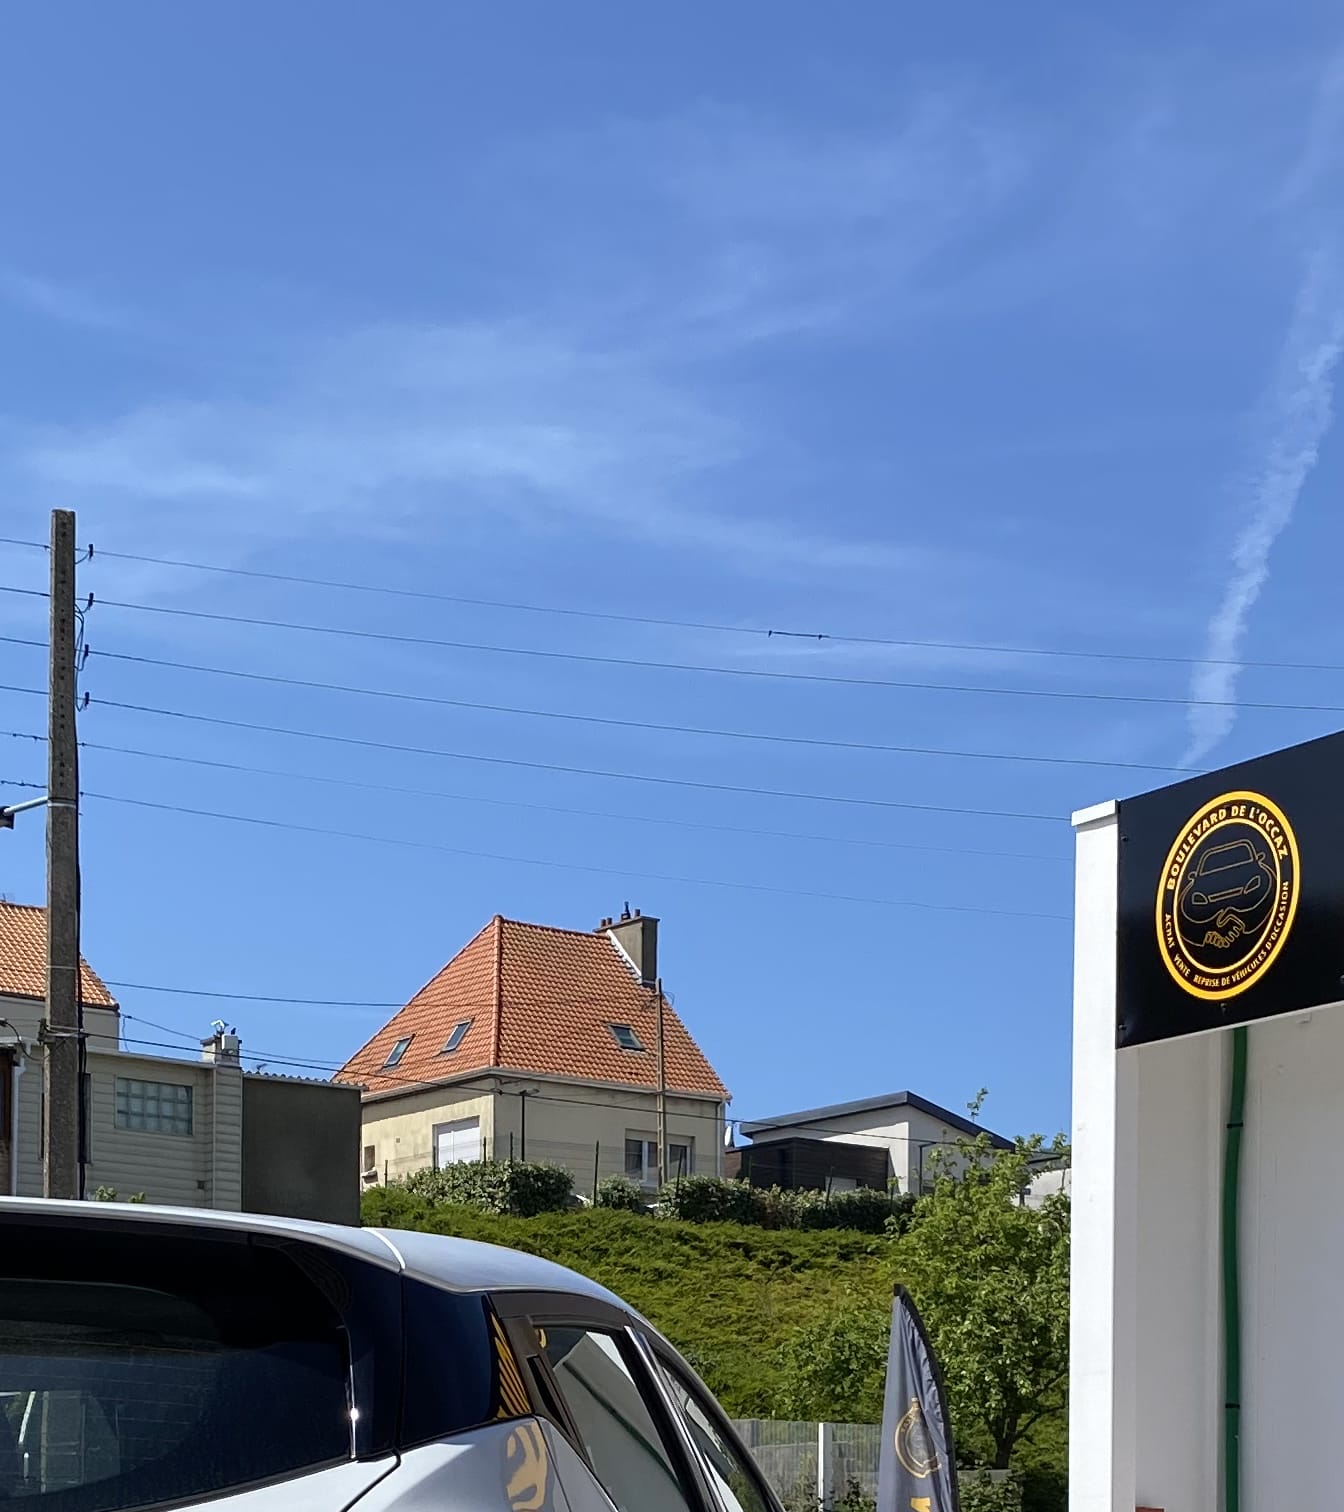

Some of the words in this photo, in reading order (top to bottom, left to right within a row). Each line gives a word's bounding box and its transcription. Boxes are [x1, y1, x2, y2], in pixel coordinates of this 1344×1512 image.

[1166, 809, 1227, 890] BOULEVARD
[1231, 805, 1247, 817] DE
[1249, 806, 1289, 860] L'OCCAZ
[1174, 953, 1191, 977] VENTE
[1193, 974, 1220, 987] REPRISE
[1221, 975, 1231, 987] DE
[1265, 881, 1289, 950] D'OCCASION
